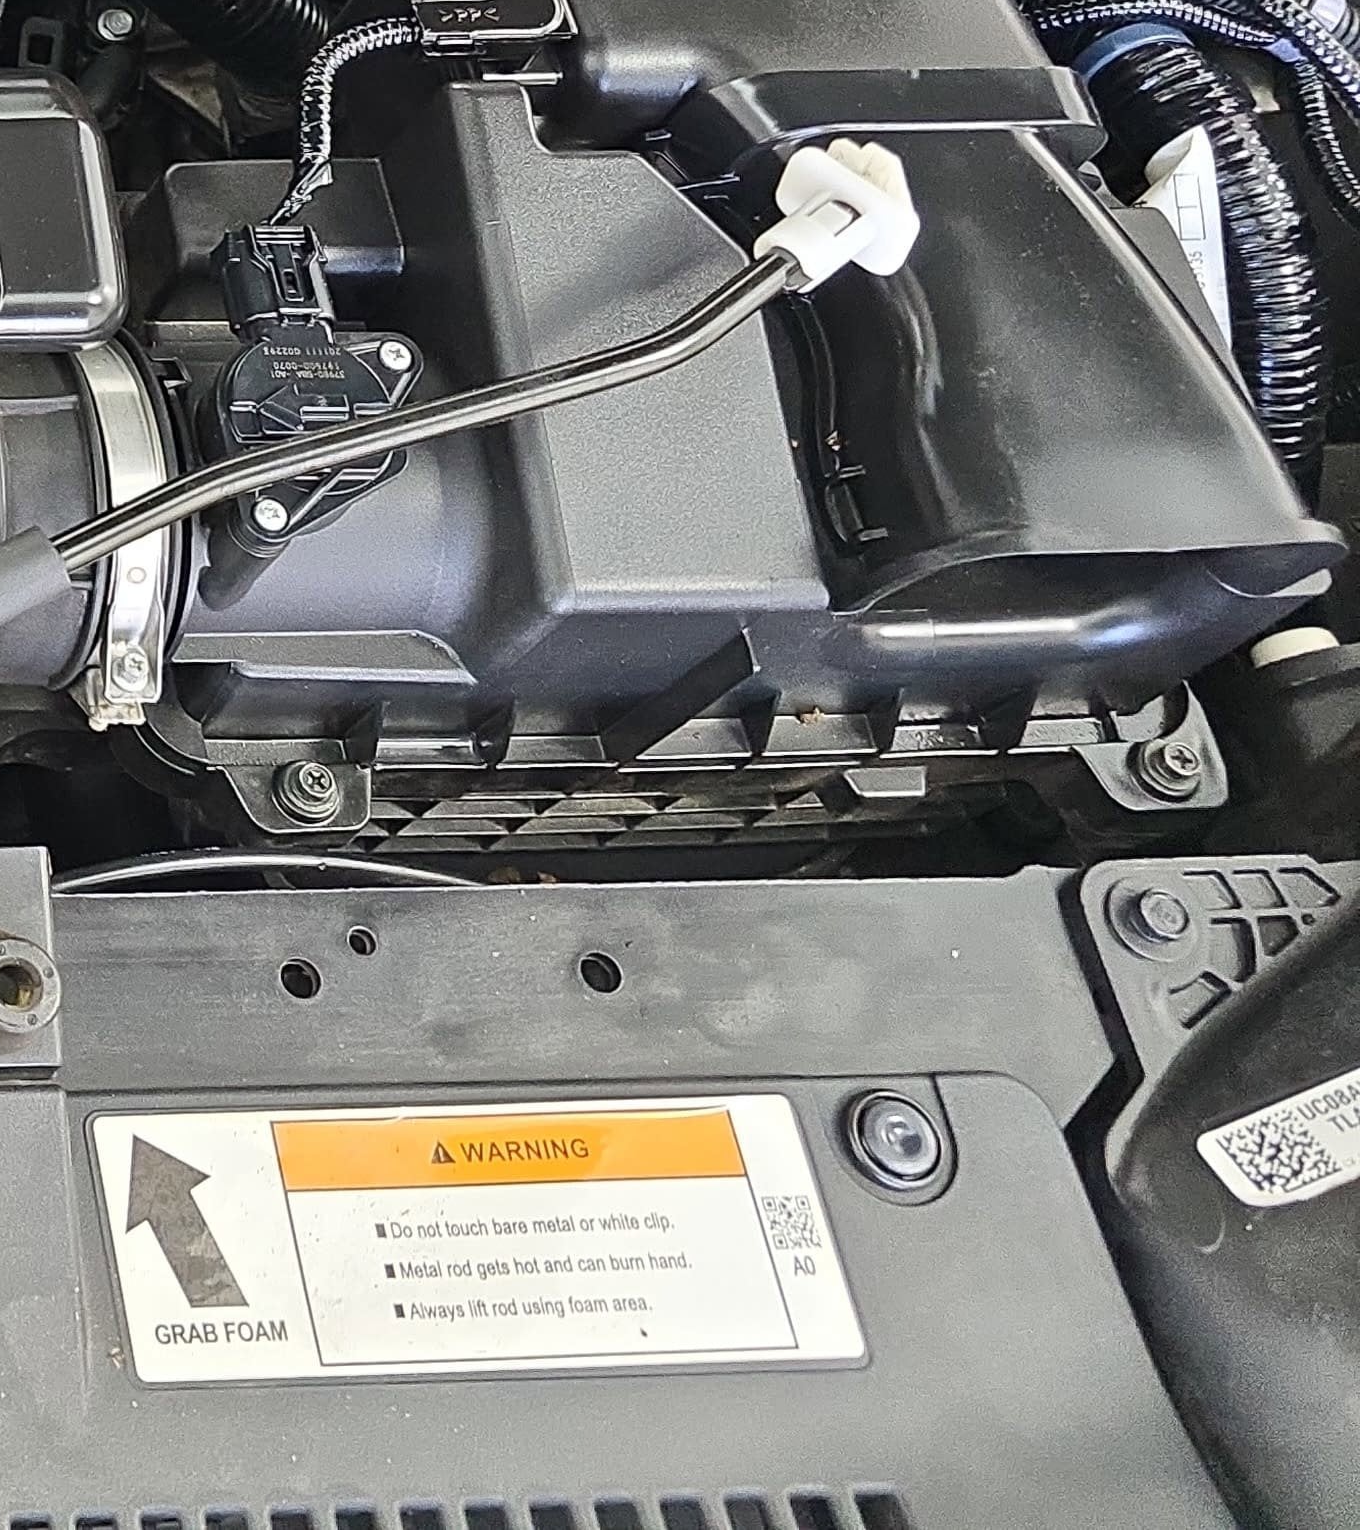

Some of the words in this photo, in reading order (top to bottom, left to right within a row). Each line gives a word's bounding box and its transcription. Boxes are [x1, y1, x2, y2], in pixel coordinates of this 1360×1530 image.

[1297, 1081, 1360, 1120] UC08A
[460, 1138, 590, 1163] WARNING
[390, 1221, 412, 1239] Do
[416, 1222, 441, 1238] not
[444, 1219, 488, 1237] touch
[492, 1218, 529, 1235] bare
[532, 1216, 575, 1233] metal
[579, 1219, 595, 1232] or
[598, 1213, 640, 1230] white
[644, 1212, 675, 1233] clip.
[399, 1261, 443, 1280] Metal
[446, 1260, 473, 1277] rod
[477, 1261, 510, 1281] gets
[513, 1258, 540, 1274] hot
[544, 1257, 574, 1273] and
[578, 1258, 605, 1272] can
[609, 1254, 645, 1270] burn
[648, 1252, 693, 1270] hand.
[410, 1301, 465, 1322] Always
[469, 1300, 489, 1318] lift
[492, 1299, 518, 1316] rod
[522, 1299, 565, 1319] using
[568, 1296, 609, 1313] foam
[613, 1296, 653, 1313] area.
[155, 1323, 218, 1346] GRAB
[225, 1320, 288, 1343] FOAM
